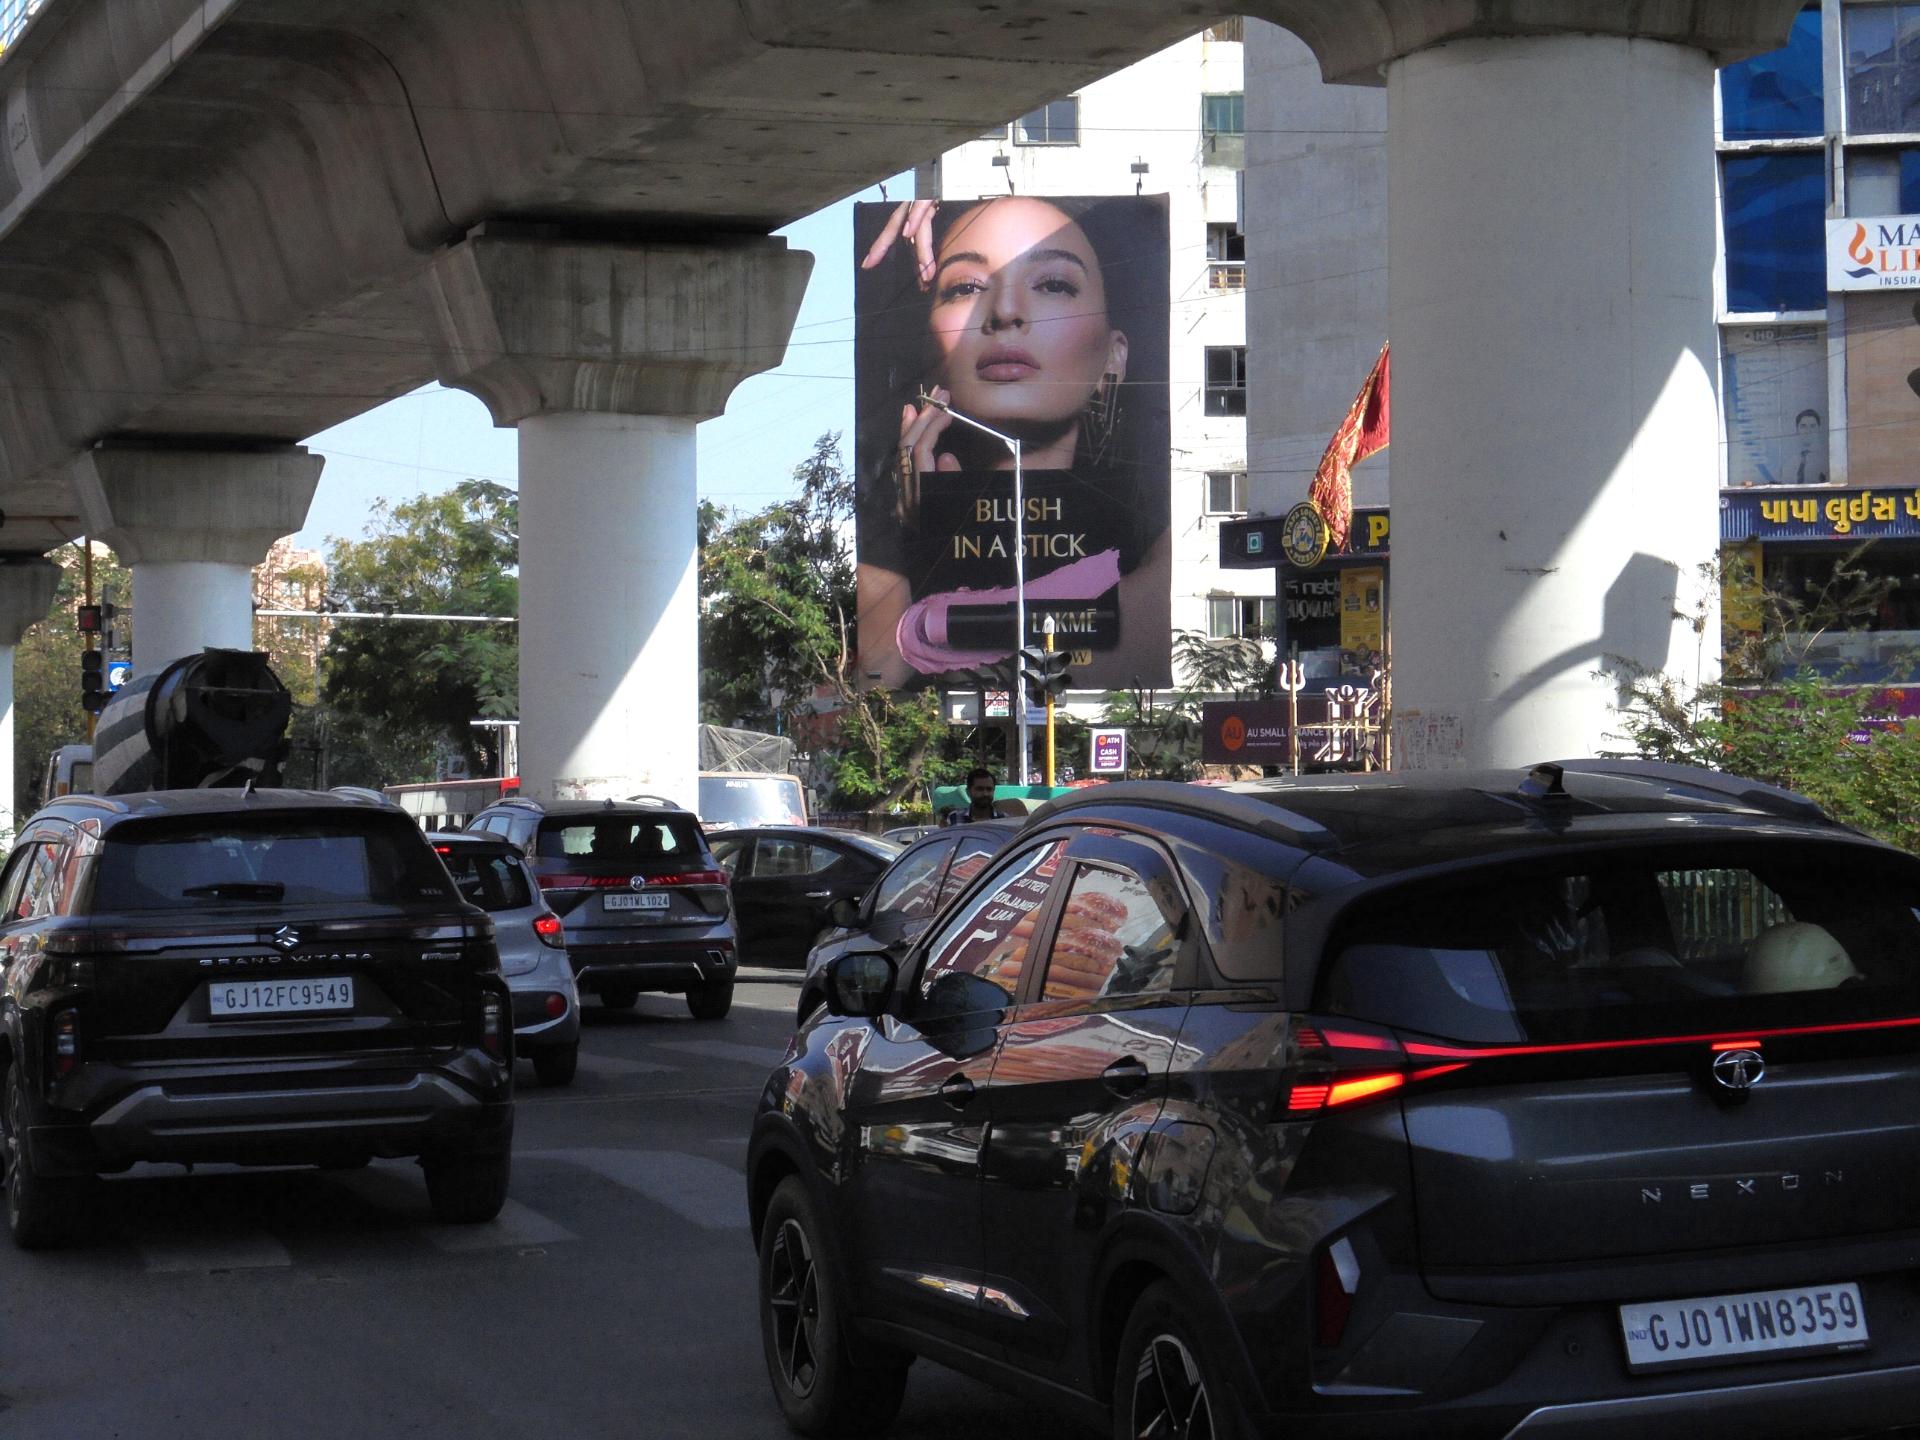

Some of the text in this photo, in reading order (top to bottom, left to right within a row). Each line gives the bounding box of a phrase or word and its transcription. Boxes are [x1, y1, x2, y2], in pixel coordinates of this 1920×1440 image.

[1878, 223, 1920, 247] MA
[976, 498, 1061, 522] BLUSH
[1761, 499, 1818, 523] પાપા
[954, 533, 1087, 558] IN A STICK
[1260, 727, 1286, 737] SMALL
[225, 983, 349, 1009] GJ12FC9549
[1641, 1170, 1843, 1204] NEXON
[1650, 1291, 1858, 1351] GJ01WN8359
